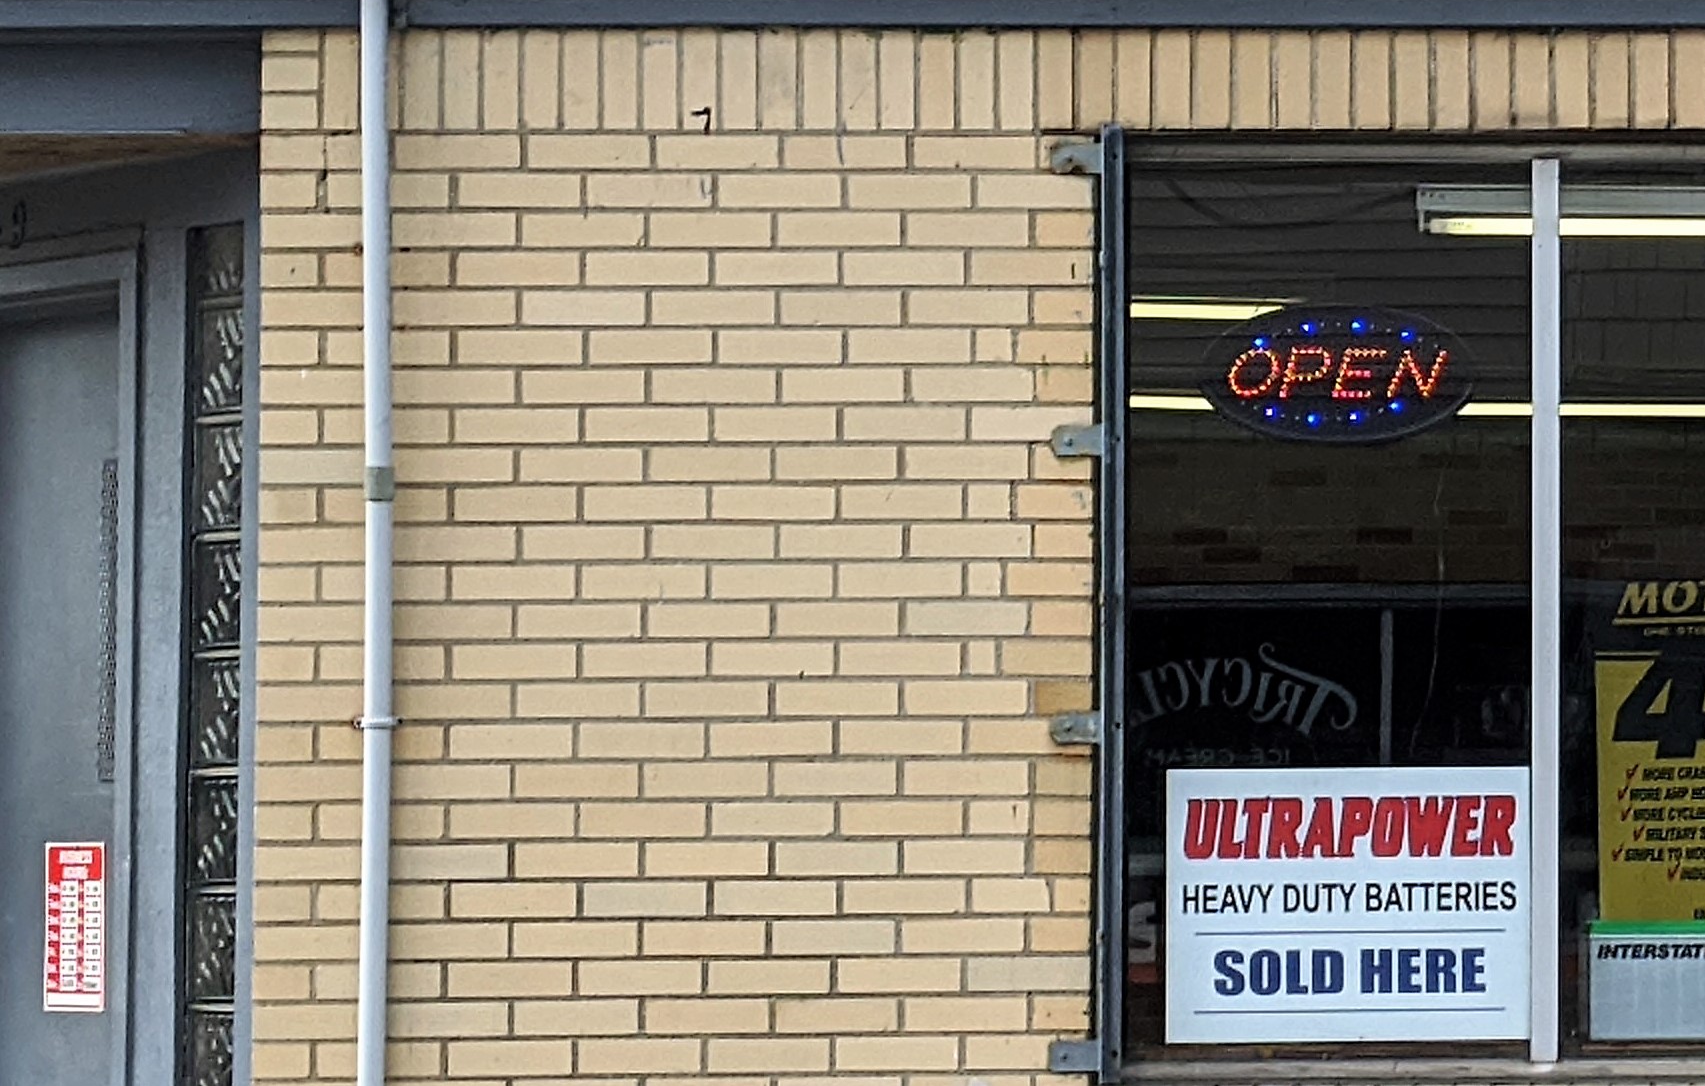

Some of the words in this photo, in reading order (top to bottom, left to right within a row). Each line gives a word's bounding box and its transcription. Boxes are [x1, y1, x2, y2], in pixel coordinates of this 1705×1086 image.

[1226, 345, 1449, 401] OPEN
[1183, 794, 1517, 860] ULTRAPOWER
[1182, 883, 1275, 915] HEAVY
[1282, 882, 1357, 914] DUTY
[1365, 880, 1517, 913] BATTERIES
[1213, 948, 1345, 997] SOLD
[1360, 947, 1487, 994] HERE
